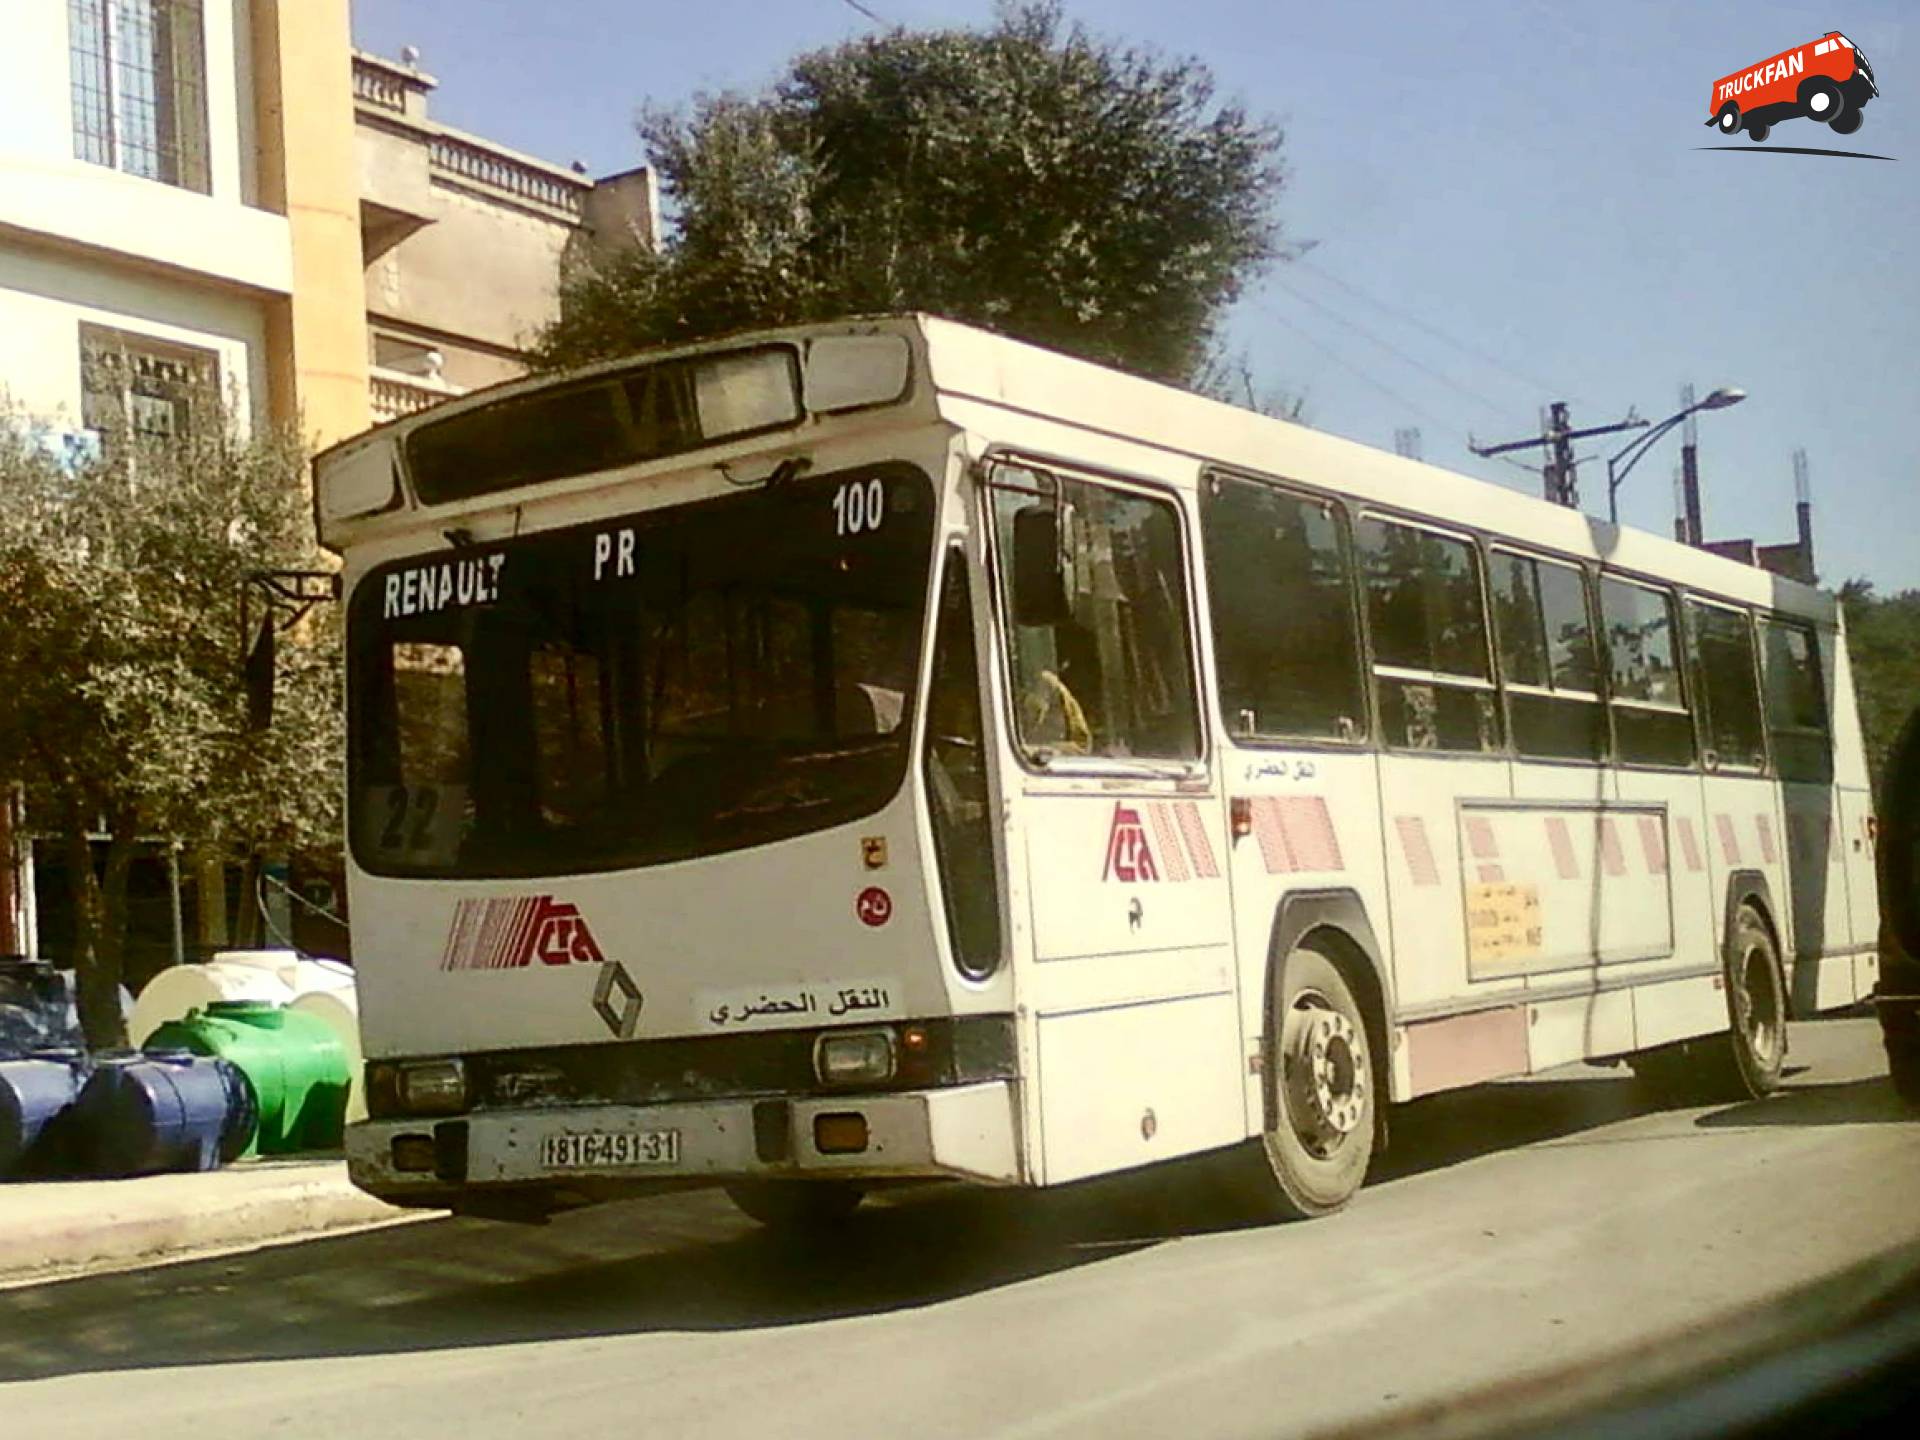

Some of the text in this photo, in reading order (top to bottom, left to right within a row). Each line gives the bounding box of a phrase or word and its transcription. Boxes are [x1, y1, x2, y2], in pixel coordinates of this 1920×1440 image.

[384, 553, 505, 619] RENAULT
[832, 478, 884, 536] 100
[709, 987, 890, 1025] النقل الحضري
